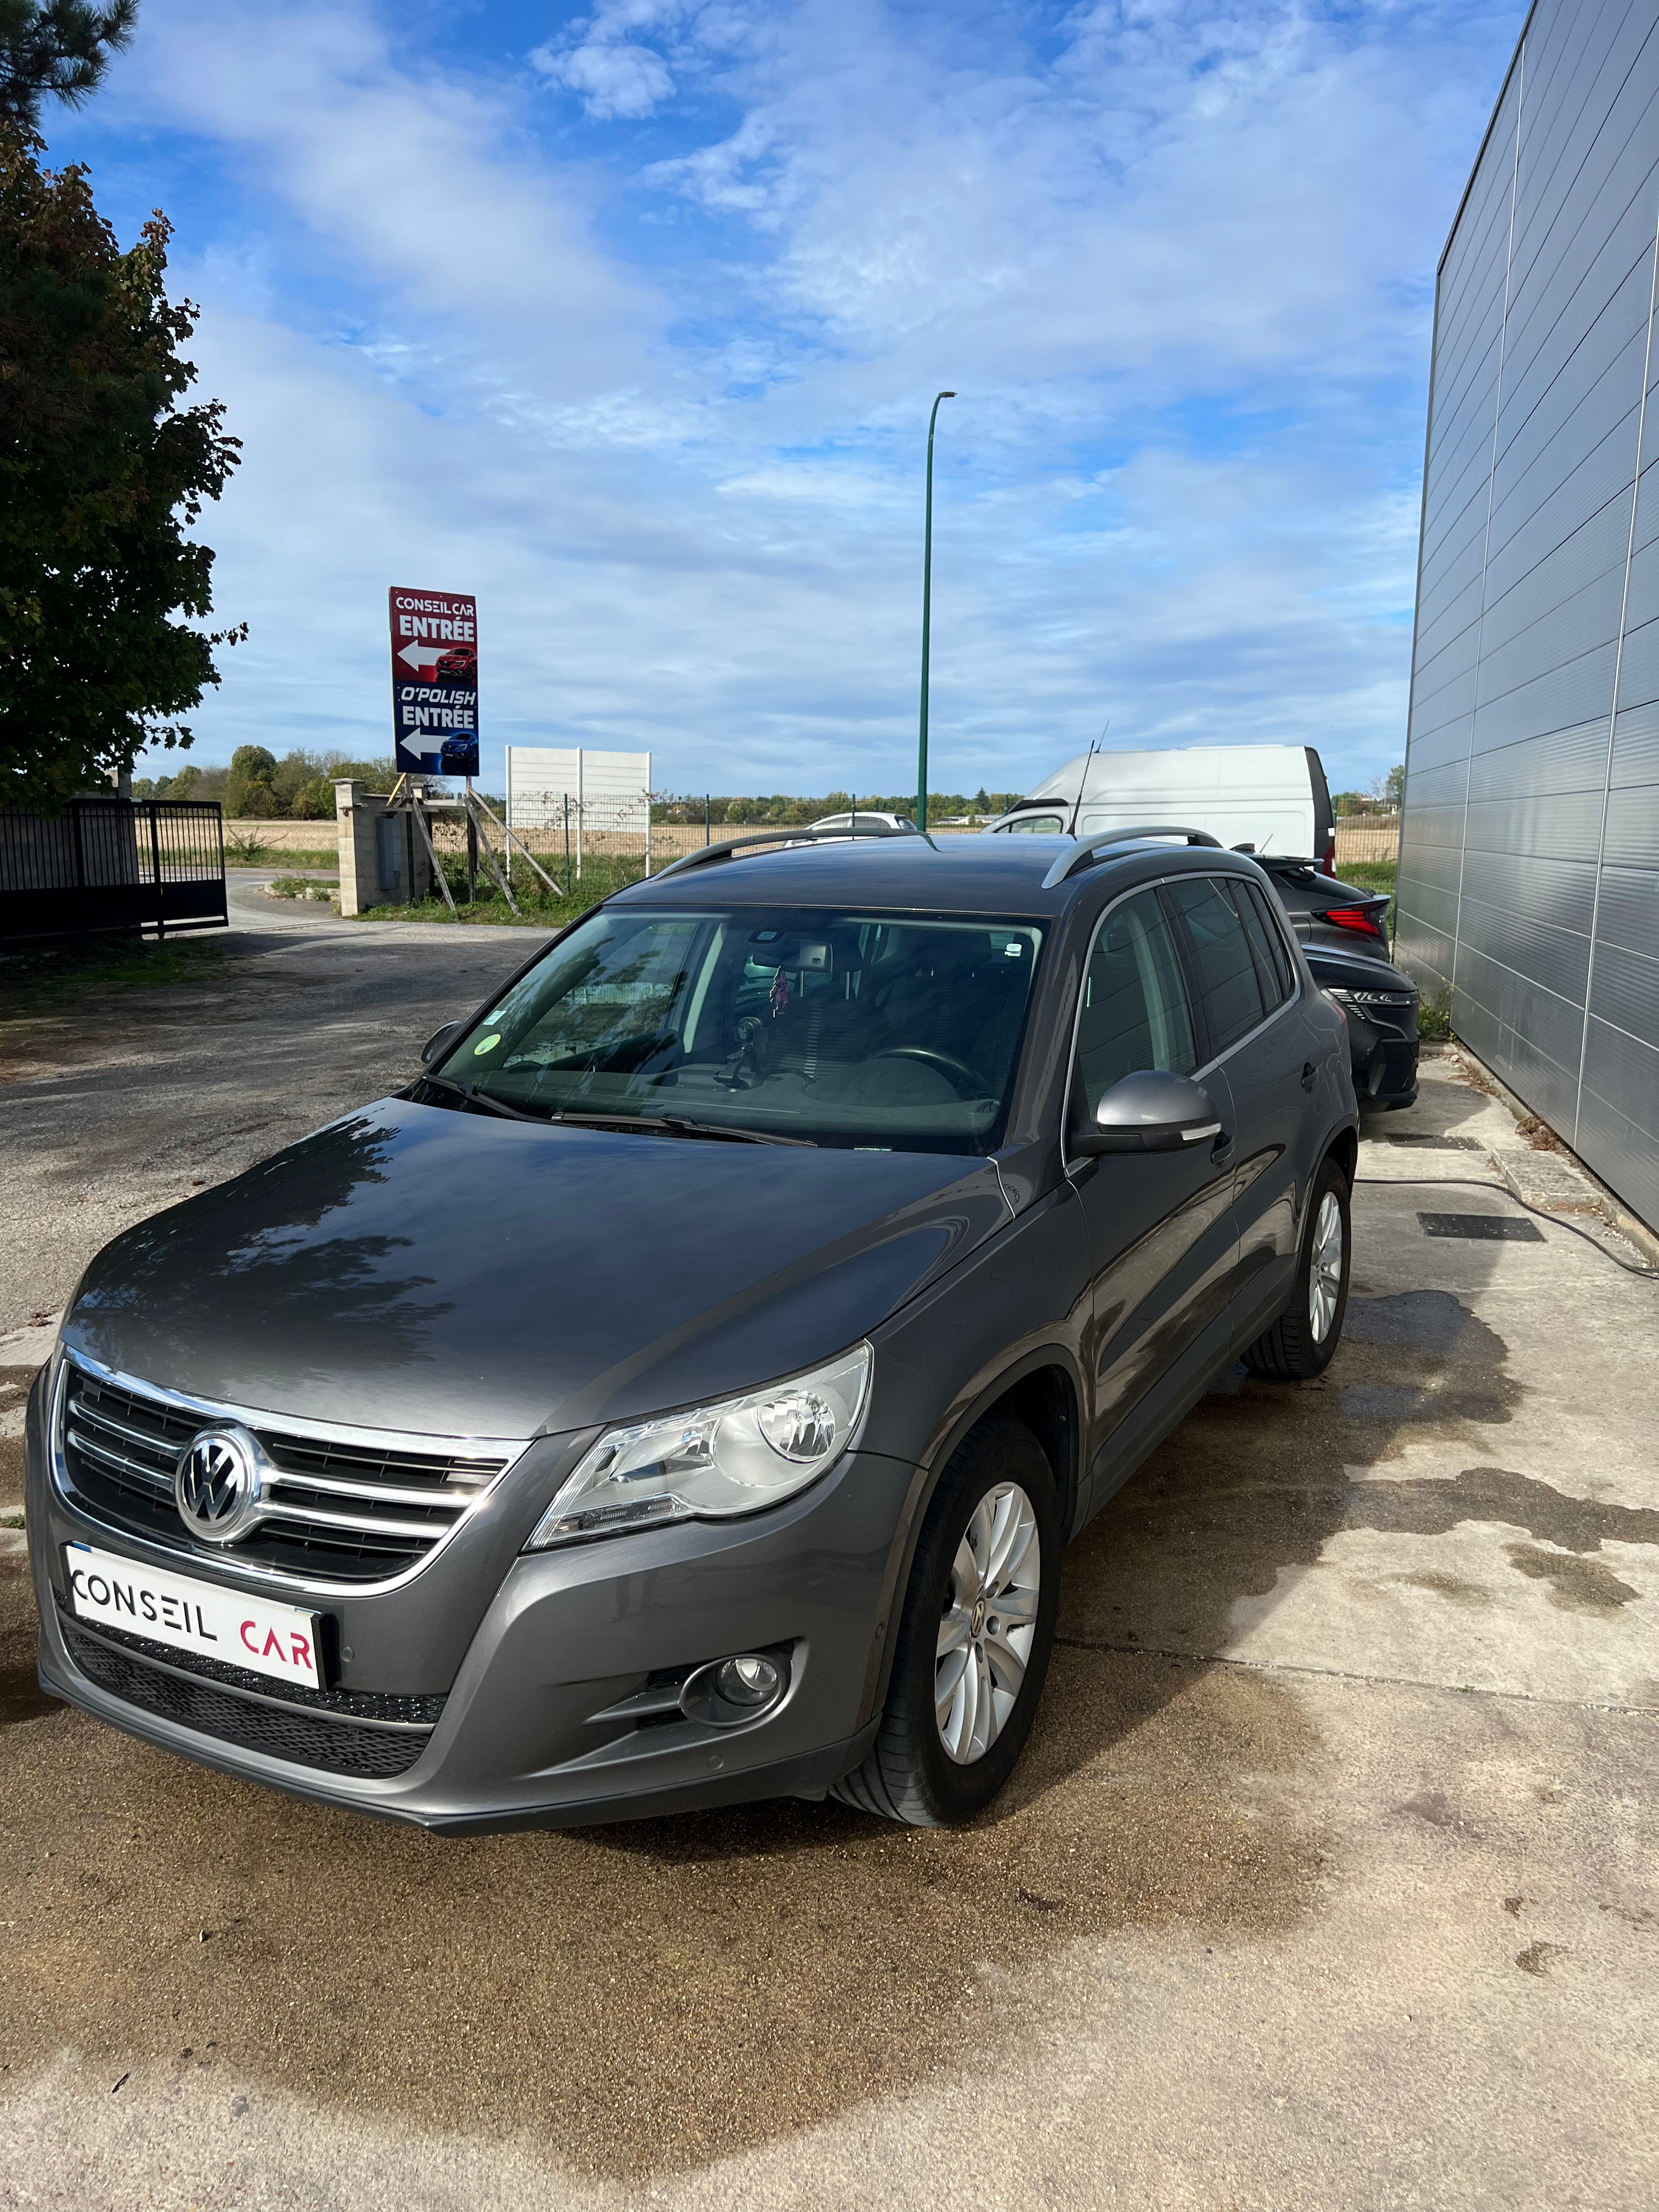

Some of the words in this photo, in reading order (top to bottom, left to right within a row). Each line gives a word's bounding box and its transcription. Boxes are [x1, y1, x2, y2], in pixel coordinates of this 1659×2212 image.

[396, 596, 452, 614] CONSEIL
[452, 603, 474, 617] CAR
[399, 615, 475, 642] ENTRÉE
[400, 686, 476, 706] O'POLISH
[402, 706, 475, 729] ENTRÉE
[70, 1569, 218, 1641] CONSEIL
[240, 1620, 313, 1669] CAR
